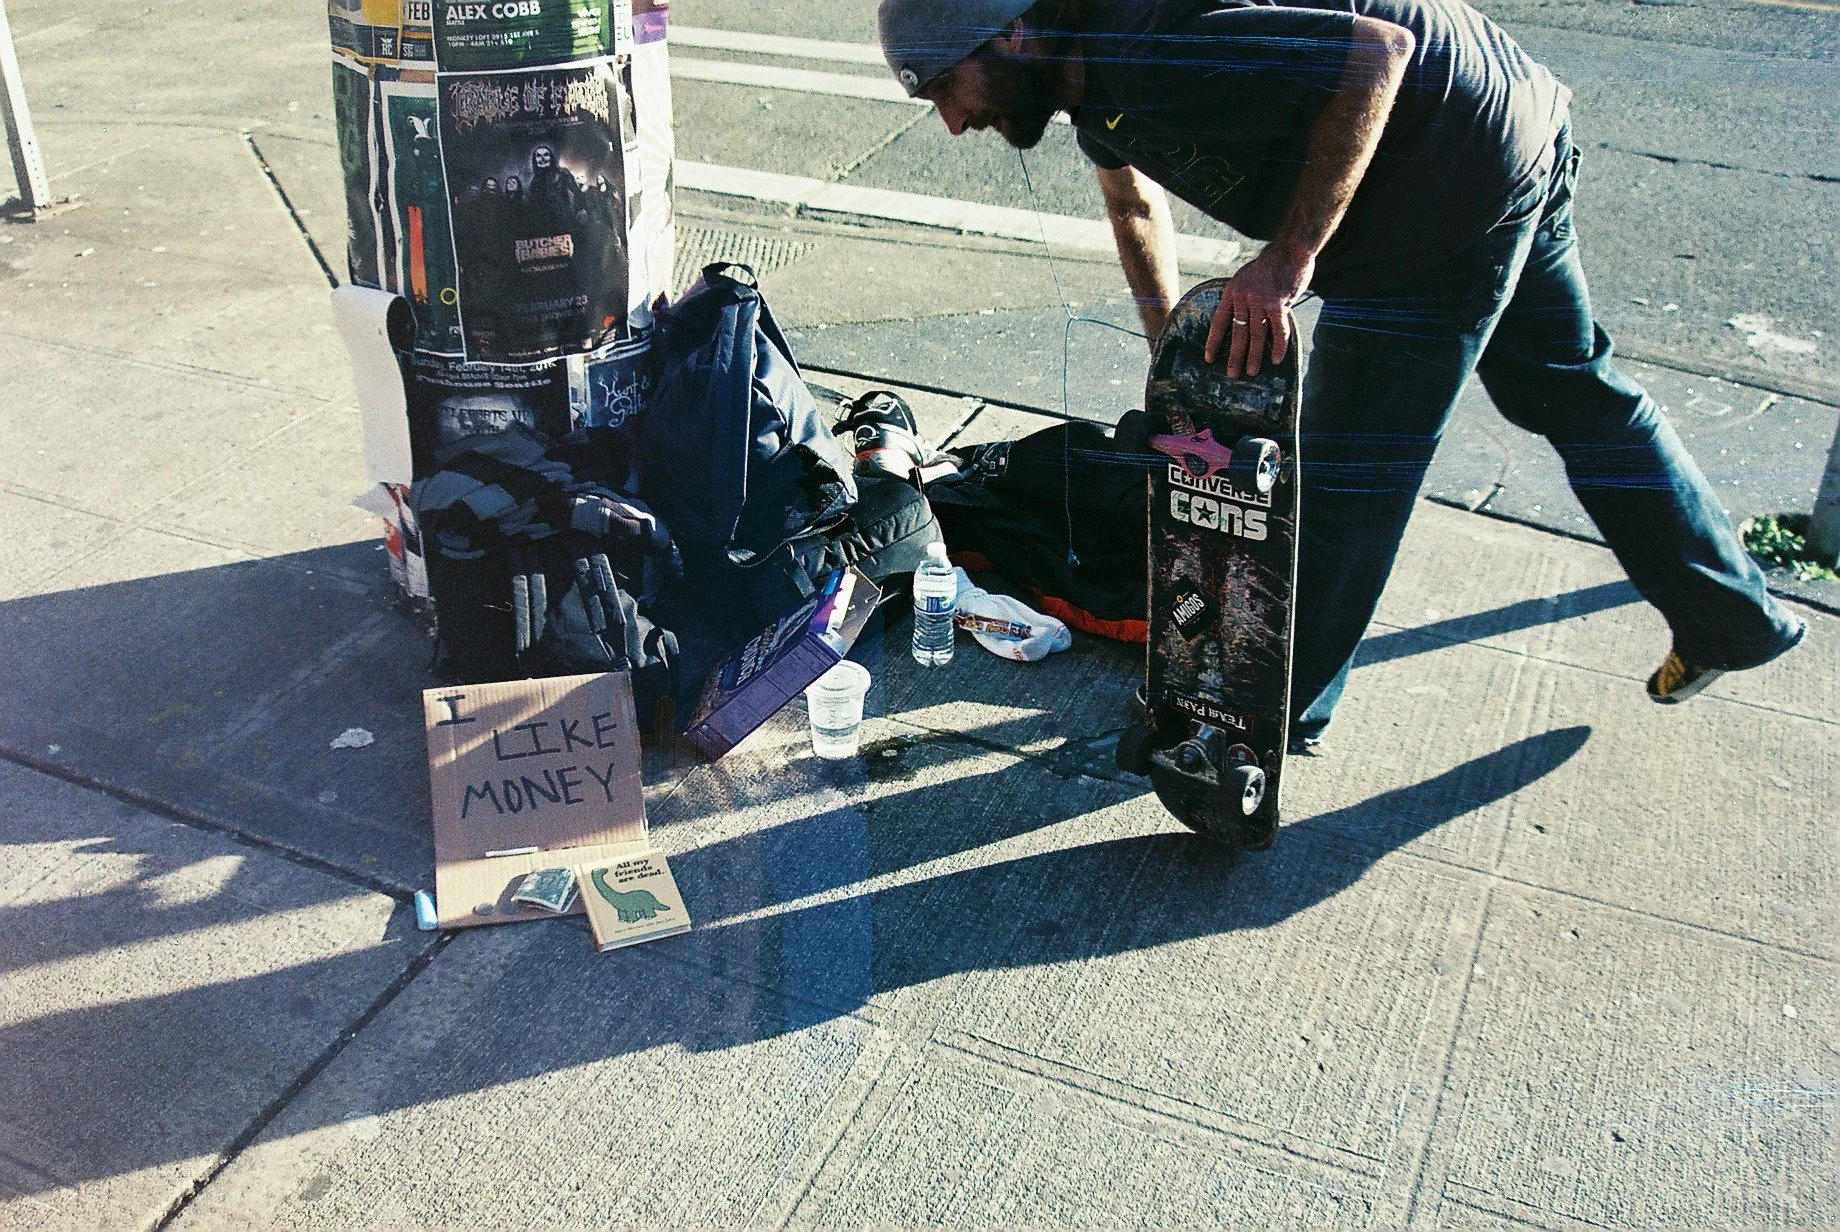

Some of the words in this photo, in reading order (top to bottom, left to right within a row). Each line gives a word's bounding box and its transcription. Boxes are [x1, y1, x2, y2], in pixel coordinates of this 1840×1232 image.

[408, 1, 431, 21] FEB
[445, 4, 488, 20] ALEX
[492, 0, 542, 19] COBB
[1170, 490, 1268, 541] CONS
[1172, 593, 1205, 626] AMIGOS
[436, 694, 475, 727] I
[493, 712, 618, 761] LIKE
[461, 763, 615, 819] MONEY
[614, 866, 653, 877] friends
[616, 862, 630, 870] All
[632, 859, 649, 868] my
[637, 869, 665, 880] dead.
